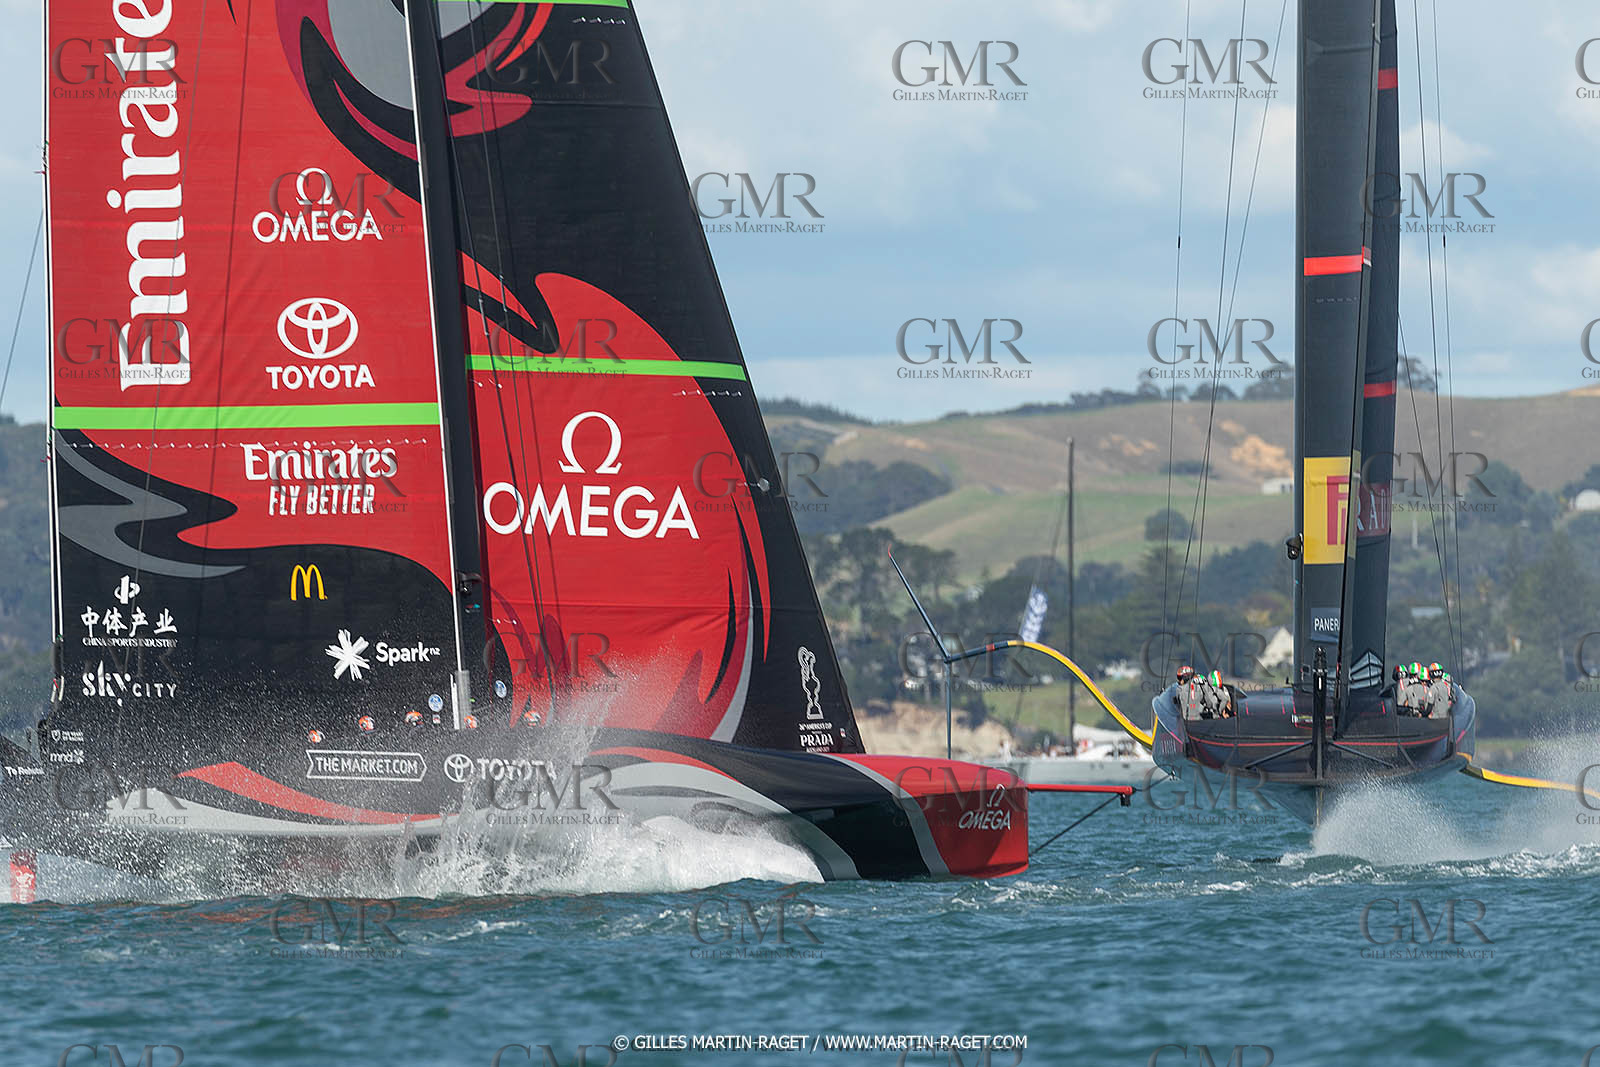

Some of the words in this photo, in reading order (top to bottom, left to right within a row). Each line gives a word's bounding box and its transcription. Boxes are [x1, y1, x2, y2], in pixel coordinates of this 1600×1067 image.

[252, 208, 383, 243] OMEGA
[265, 364, 376, 390] TOYOTA
[240, 441, 398, 480] Emirates
[268, 485, 301, 516] FLY
[306, 483, 376, 516] BETTER
[483, 481, 700, 539] OMEGA
[80, 605, 178, 638] 中体产业
[82, 637, 107, 648] CHINA
[107, 637, 138, 648] SPORTS
[376, 642, 430, 667] Spark
[132, 683, 177, 698] CITY
[800, 733, 834, 747] PRADA
[477, 758, 557, 780] TOYOTA
[959, 809, 1011, 831] OMEGA
